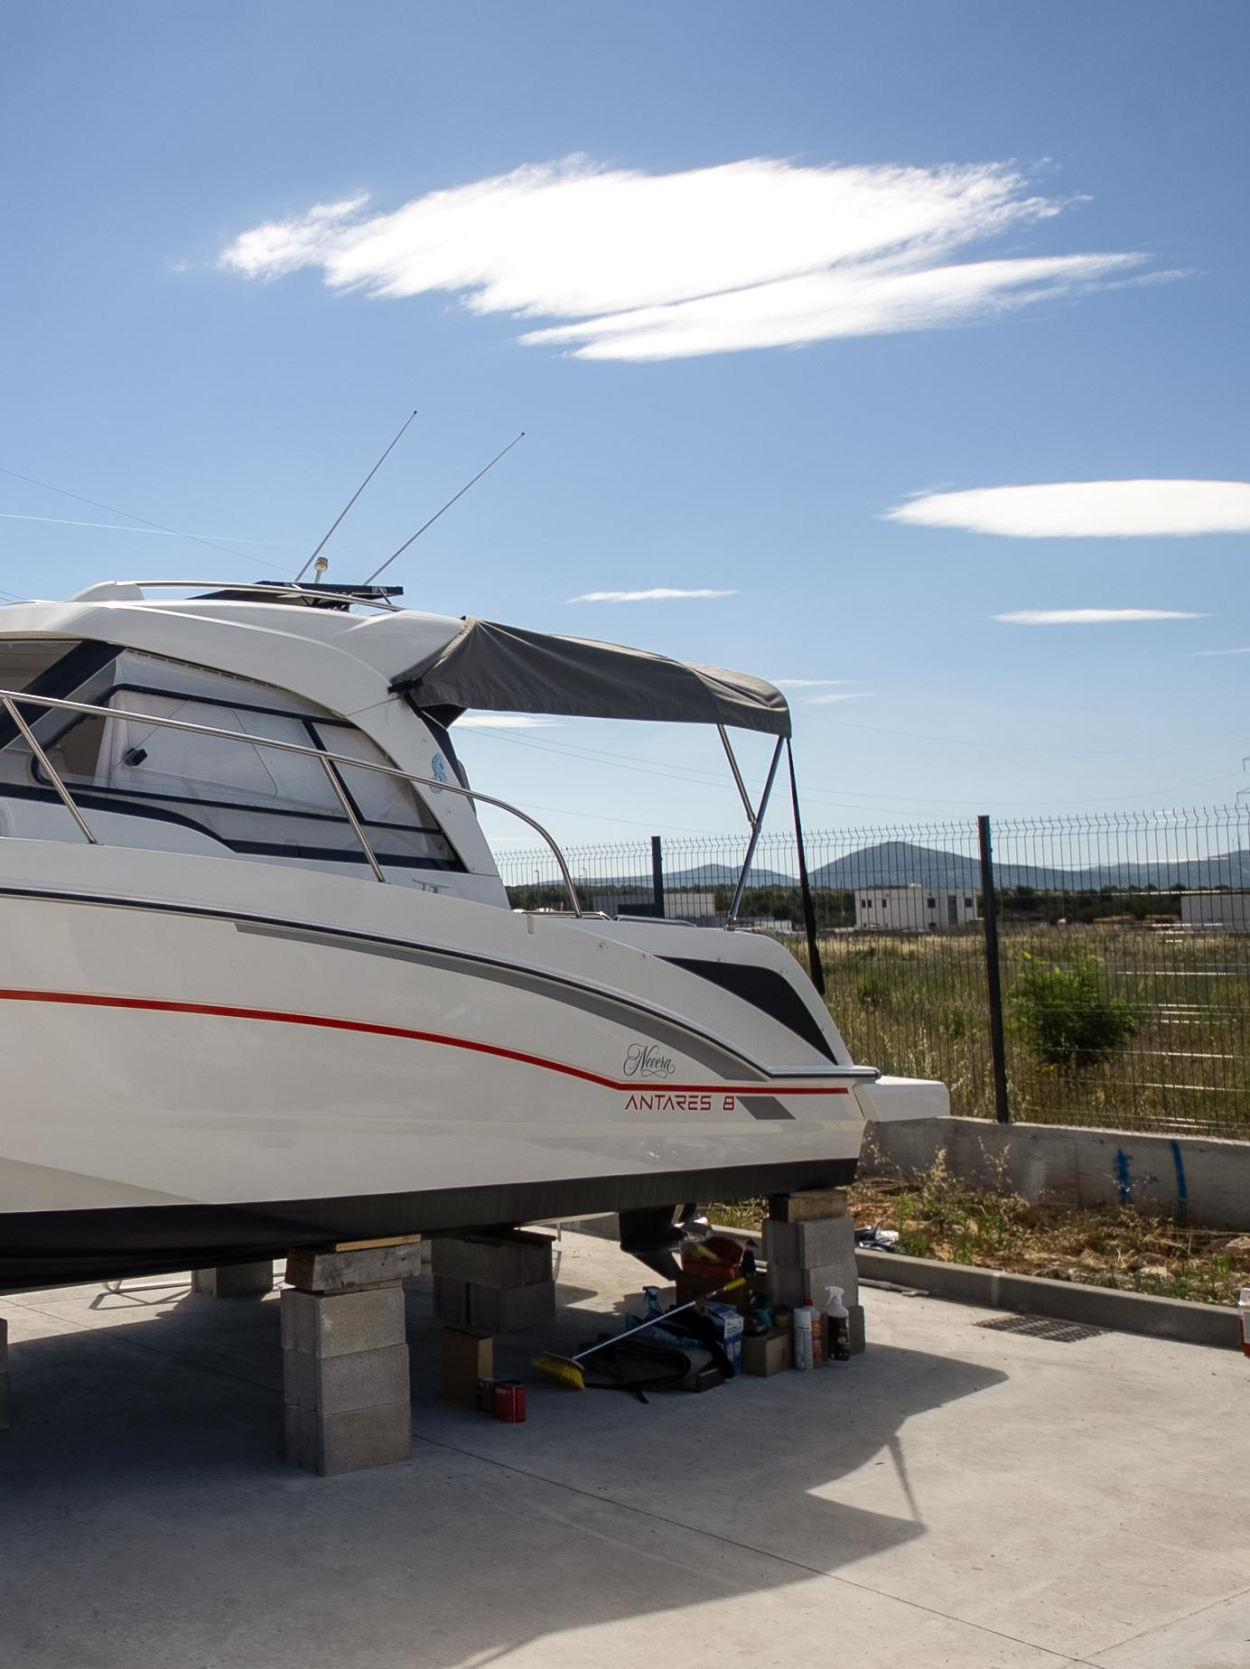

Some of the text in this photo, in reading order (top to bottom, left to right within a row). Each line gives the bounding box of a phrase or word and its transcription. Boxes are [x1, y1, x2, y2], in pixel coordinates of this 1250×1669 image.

[623, 1043, 675, 1079] Nevera
[625, 1094, 735, 1111] ANTARES 8
